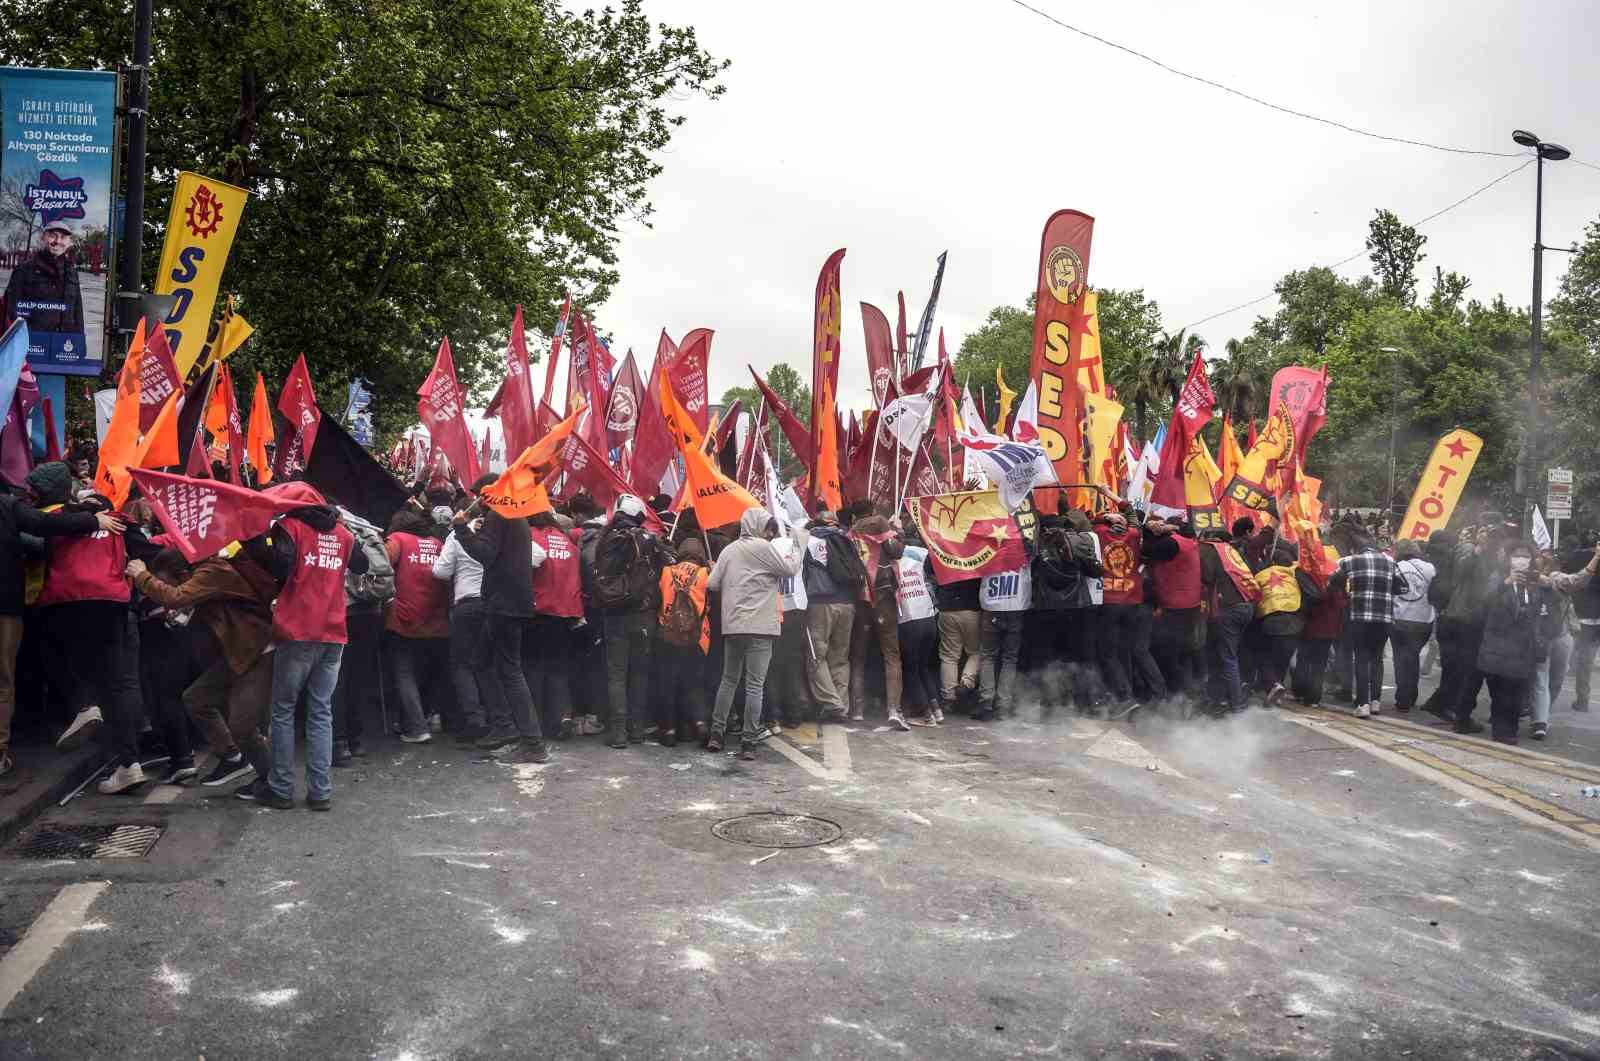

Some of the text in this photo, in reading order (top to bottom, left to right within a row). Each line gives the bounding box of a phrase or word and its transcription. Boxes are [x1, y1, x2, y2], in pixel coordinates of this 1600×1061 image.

[23, 130, 93, 143] 130 Noktada
[8, 140, 109, 154] Altyapı Sorunlarını
[36, 152, 78, 164] Çözdük
[28, 186, 85, 200] İSTANBUL
[1409, 464, 1458, 540] TÖP
[549, 549, 571, 560] EHP
[318, 555, 343, 570] EHP
